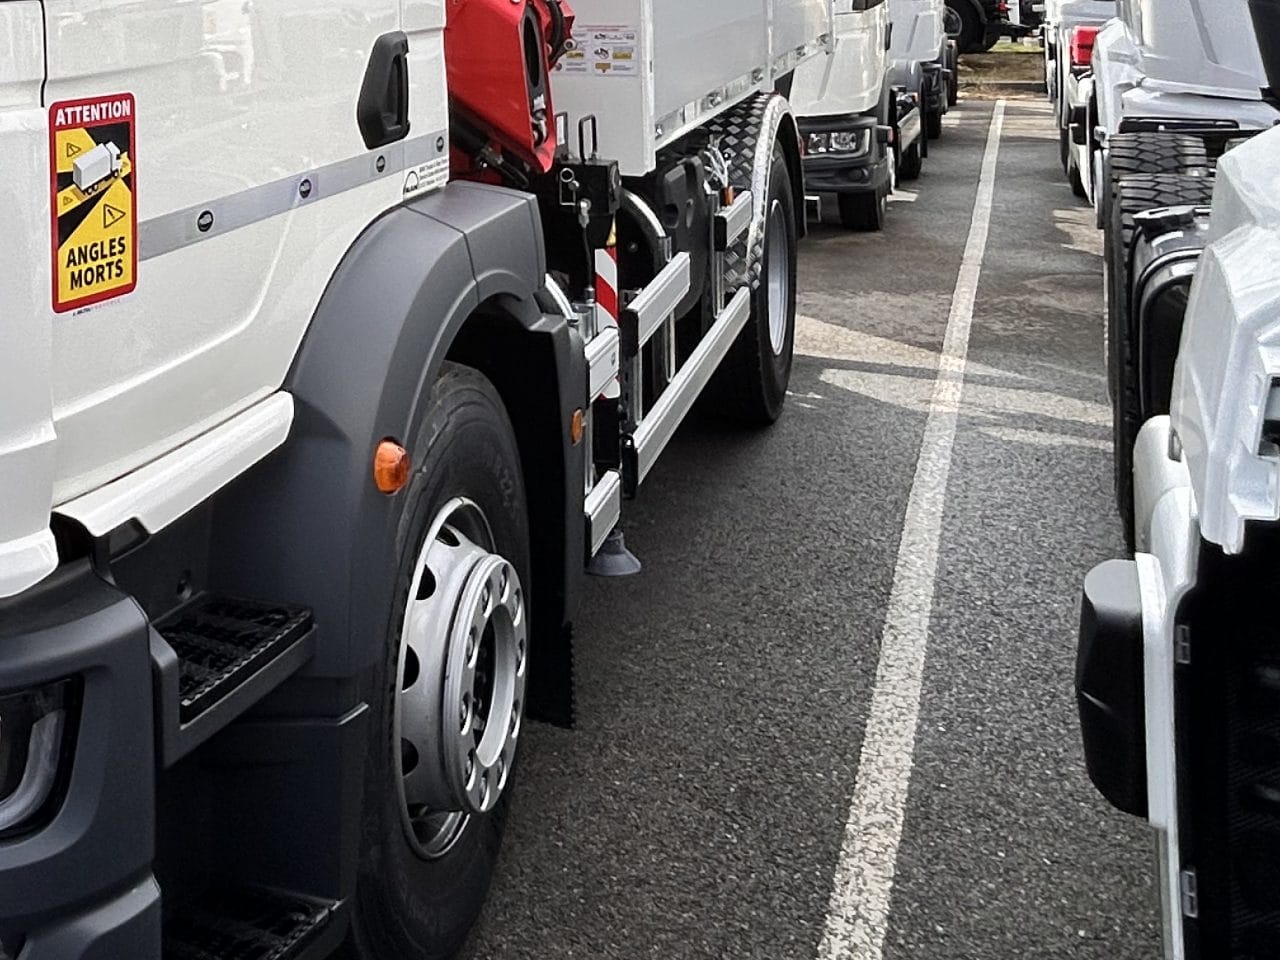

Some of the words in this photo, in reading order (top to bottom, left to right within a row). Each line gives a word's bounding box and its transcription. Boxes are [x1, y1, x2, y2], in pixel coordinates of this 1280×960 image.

[55, 99, 131, 126] ATTENTION
[66, 235, 126, 269] ANGLES
[70, 258, 124, 291] MORTS
